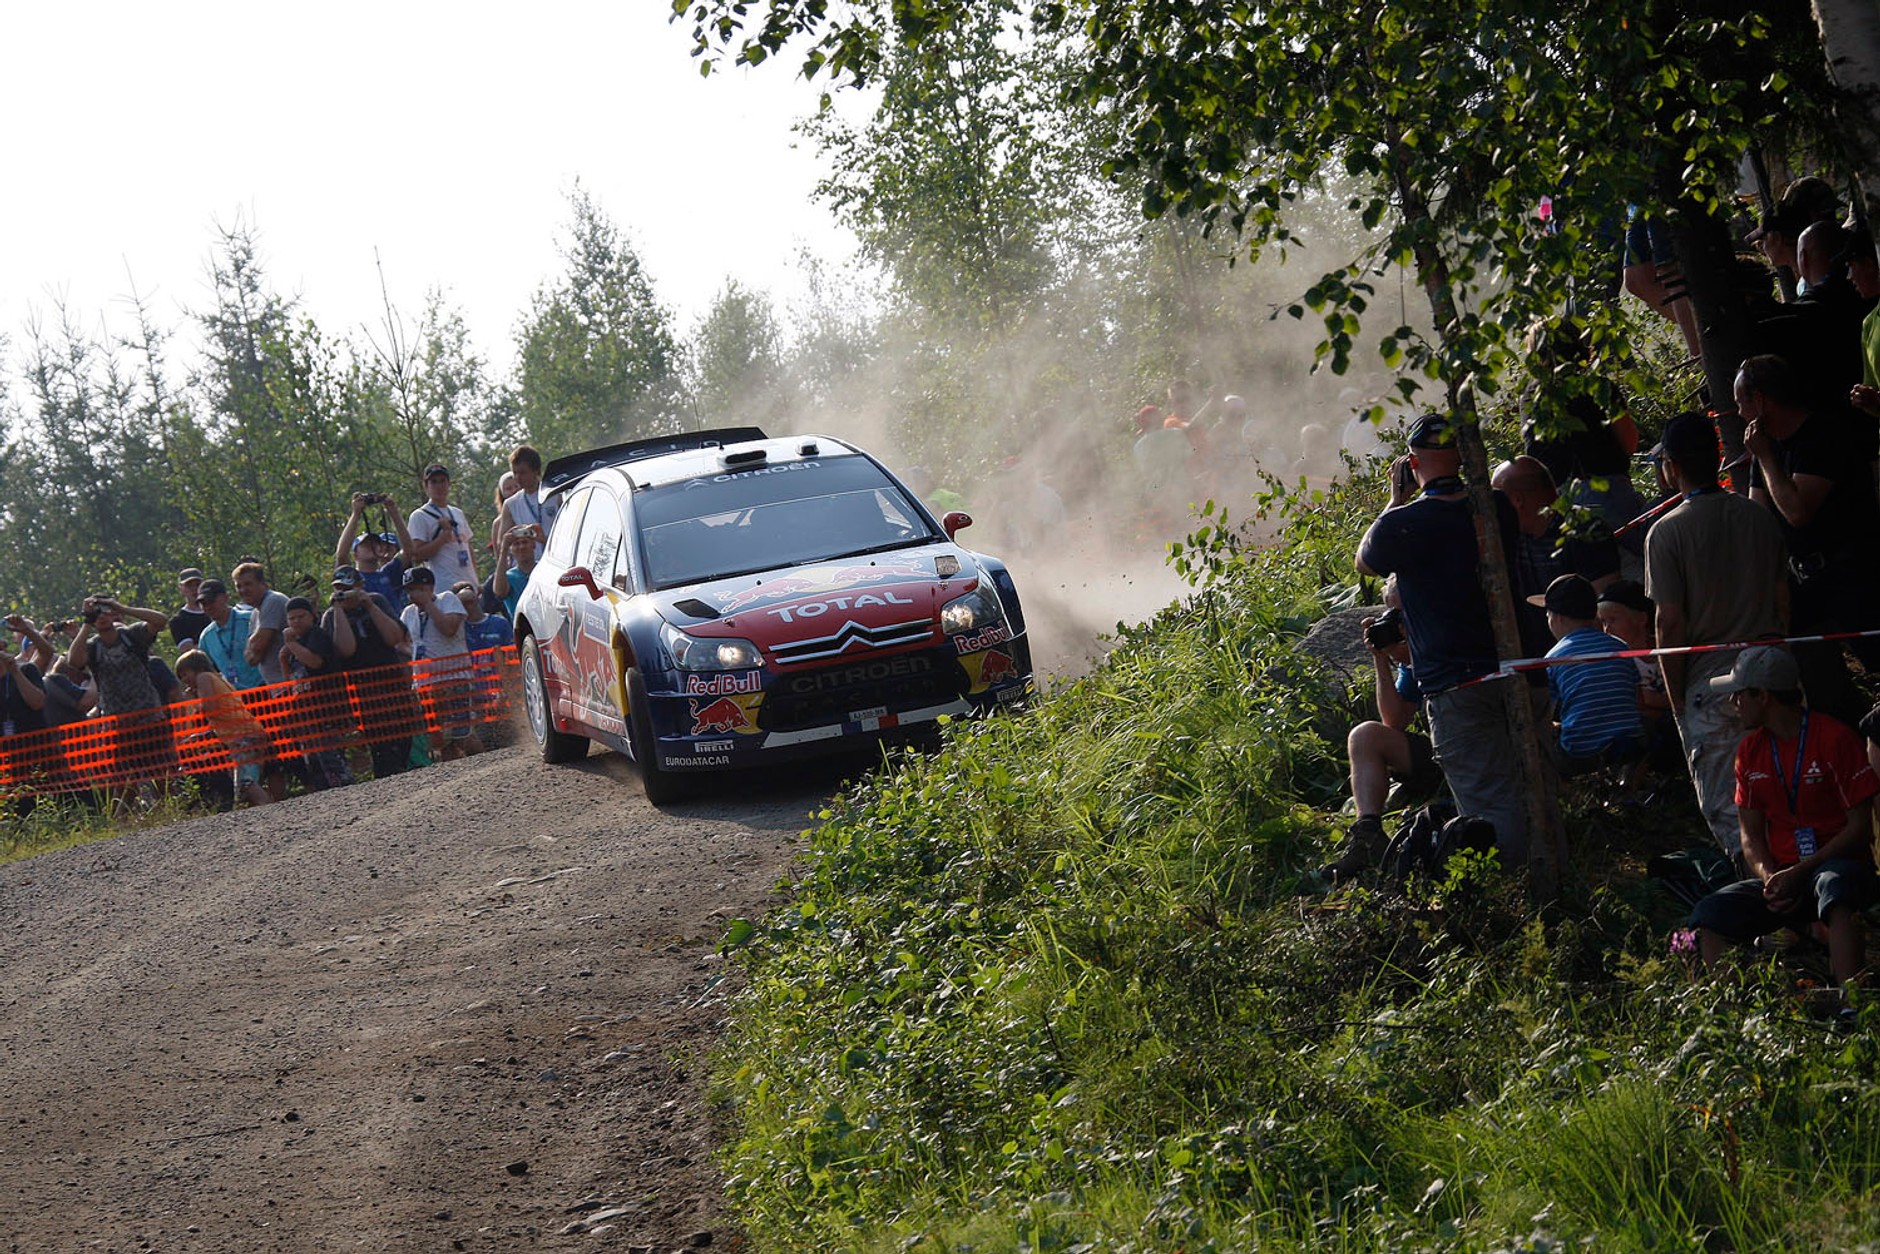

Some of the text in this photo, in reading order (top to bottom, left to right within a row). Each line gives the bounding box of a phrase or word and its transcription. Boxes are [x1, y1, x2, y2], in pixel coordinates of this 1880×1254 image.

[561, 574, 584, 582] TOTAL
[767, 592, 913, 623] TOTAL
[953, 627, 992, 654] Red
[686, 670, 761, 696] Red Bull
[694, 740, 734, 753] PIRELLI
[665, 755, 730, 767] EURODATACAR
